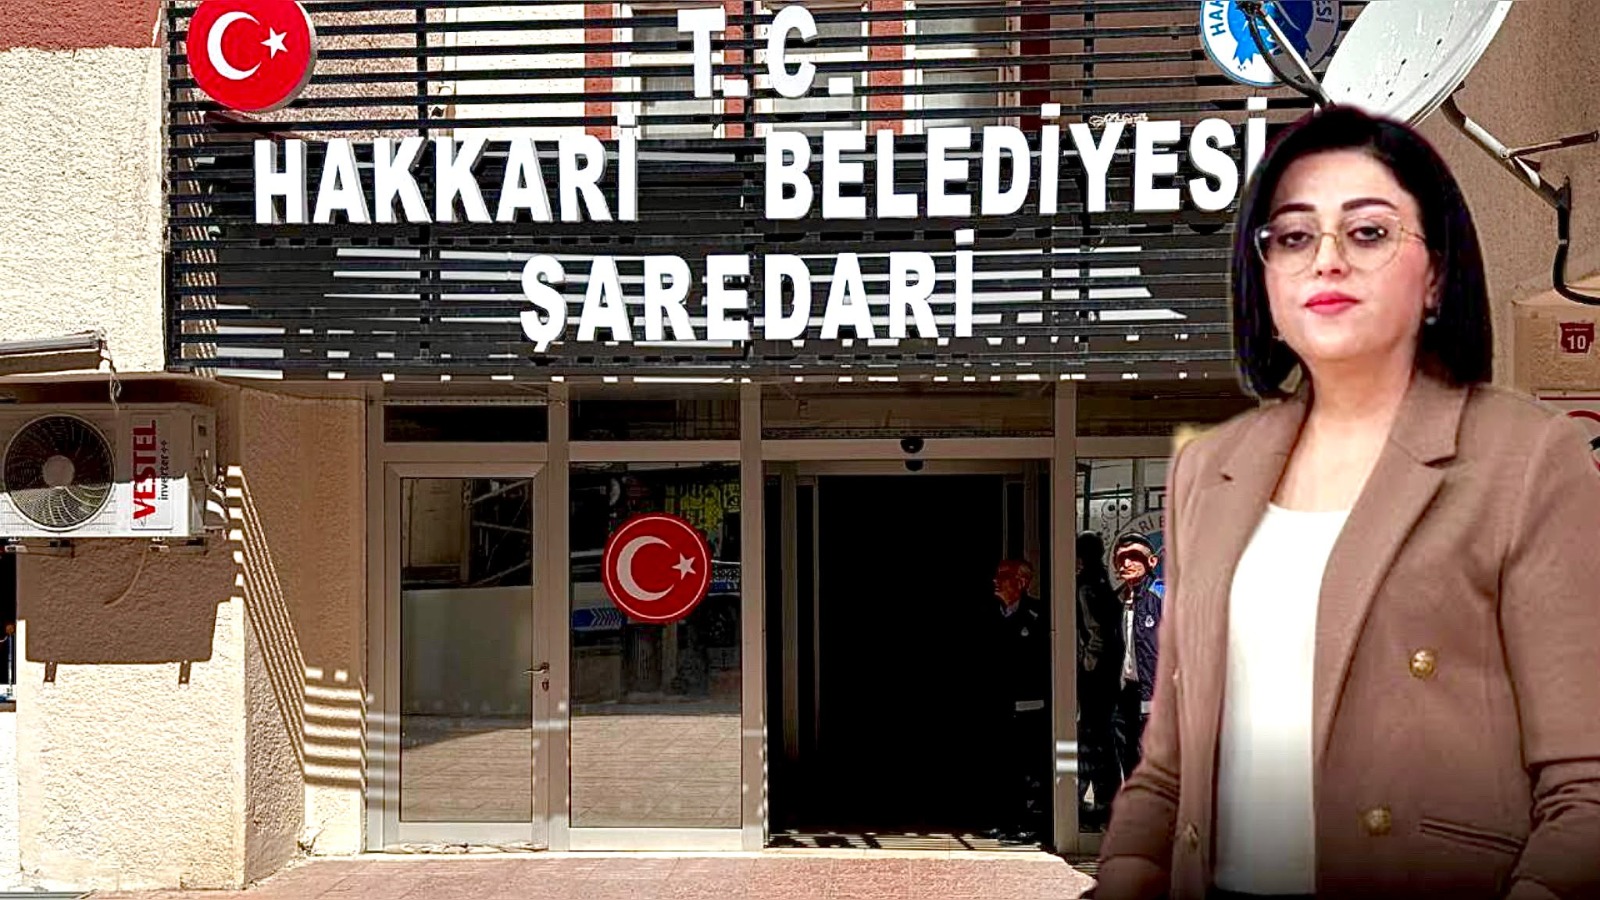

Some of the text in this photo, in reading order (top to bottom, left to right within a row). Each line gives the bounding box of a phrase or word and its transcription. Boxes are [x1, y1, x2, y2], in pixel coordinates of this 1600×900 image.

[253, 112, 640, 225] HAKKARİ
[520, 229, 976, 353] ŞAREDARİ
[1566, 335, 1587, 350] 10
[133, 420, 156, 519] VESTEL
